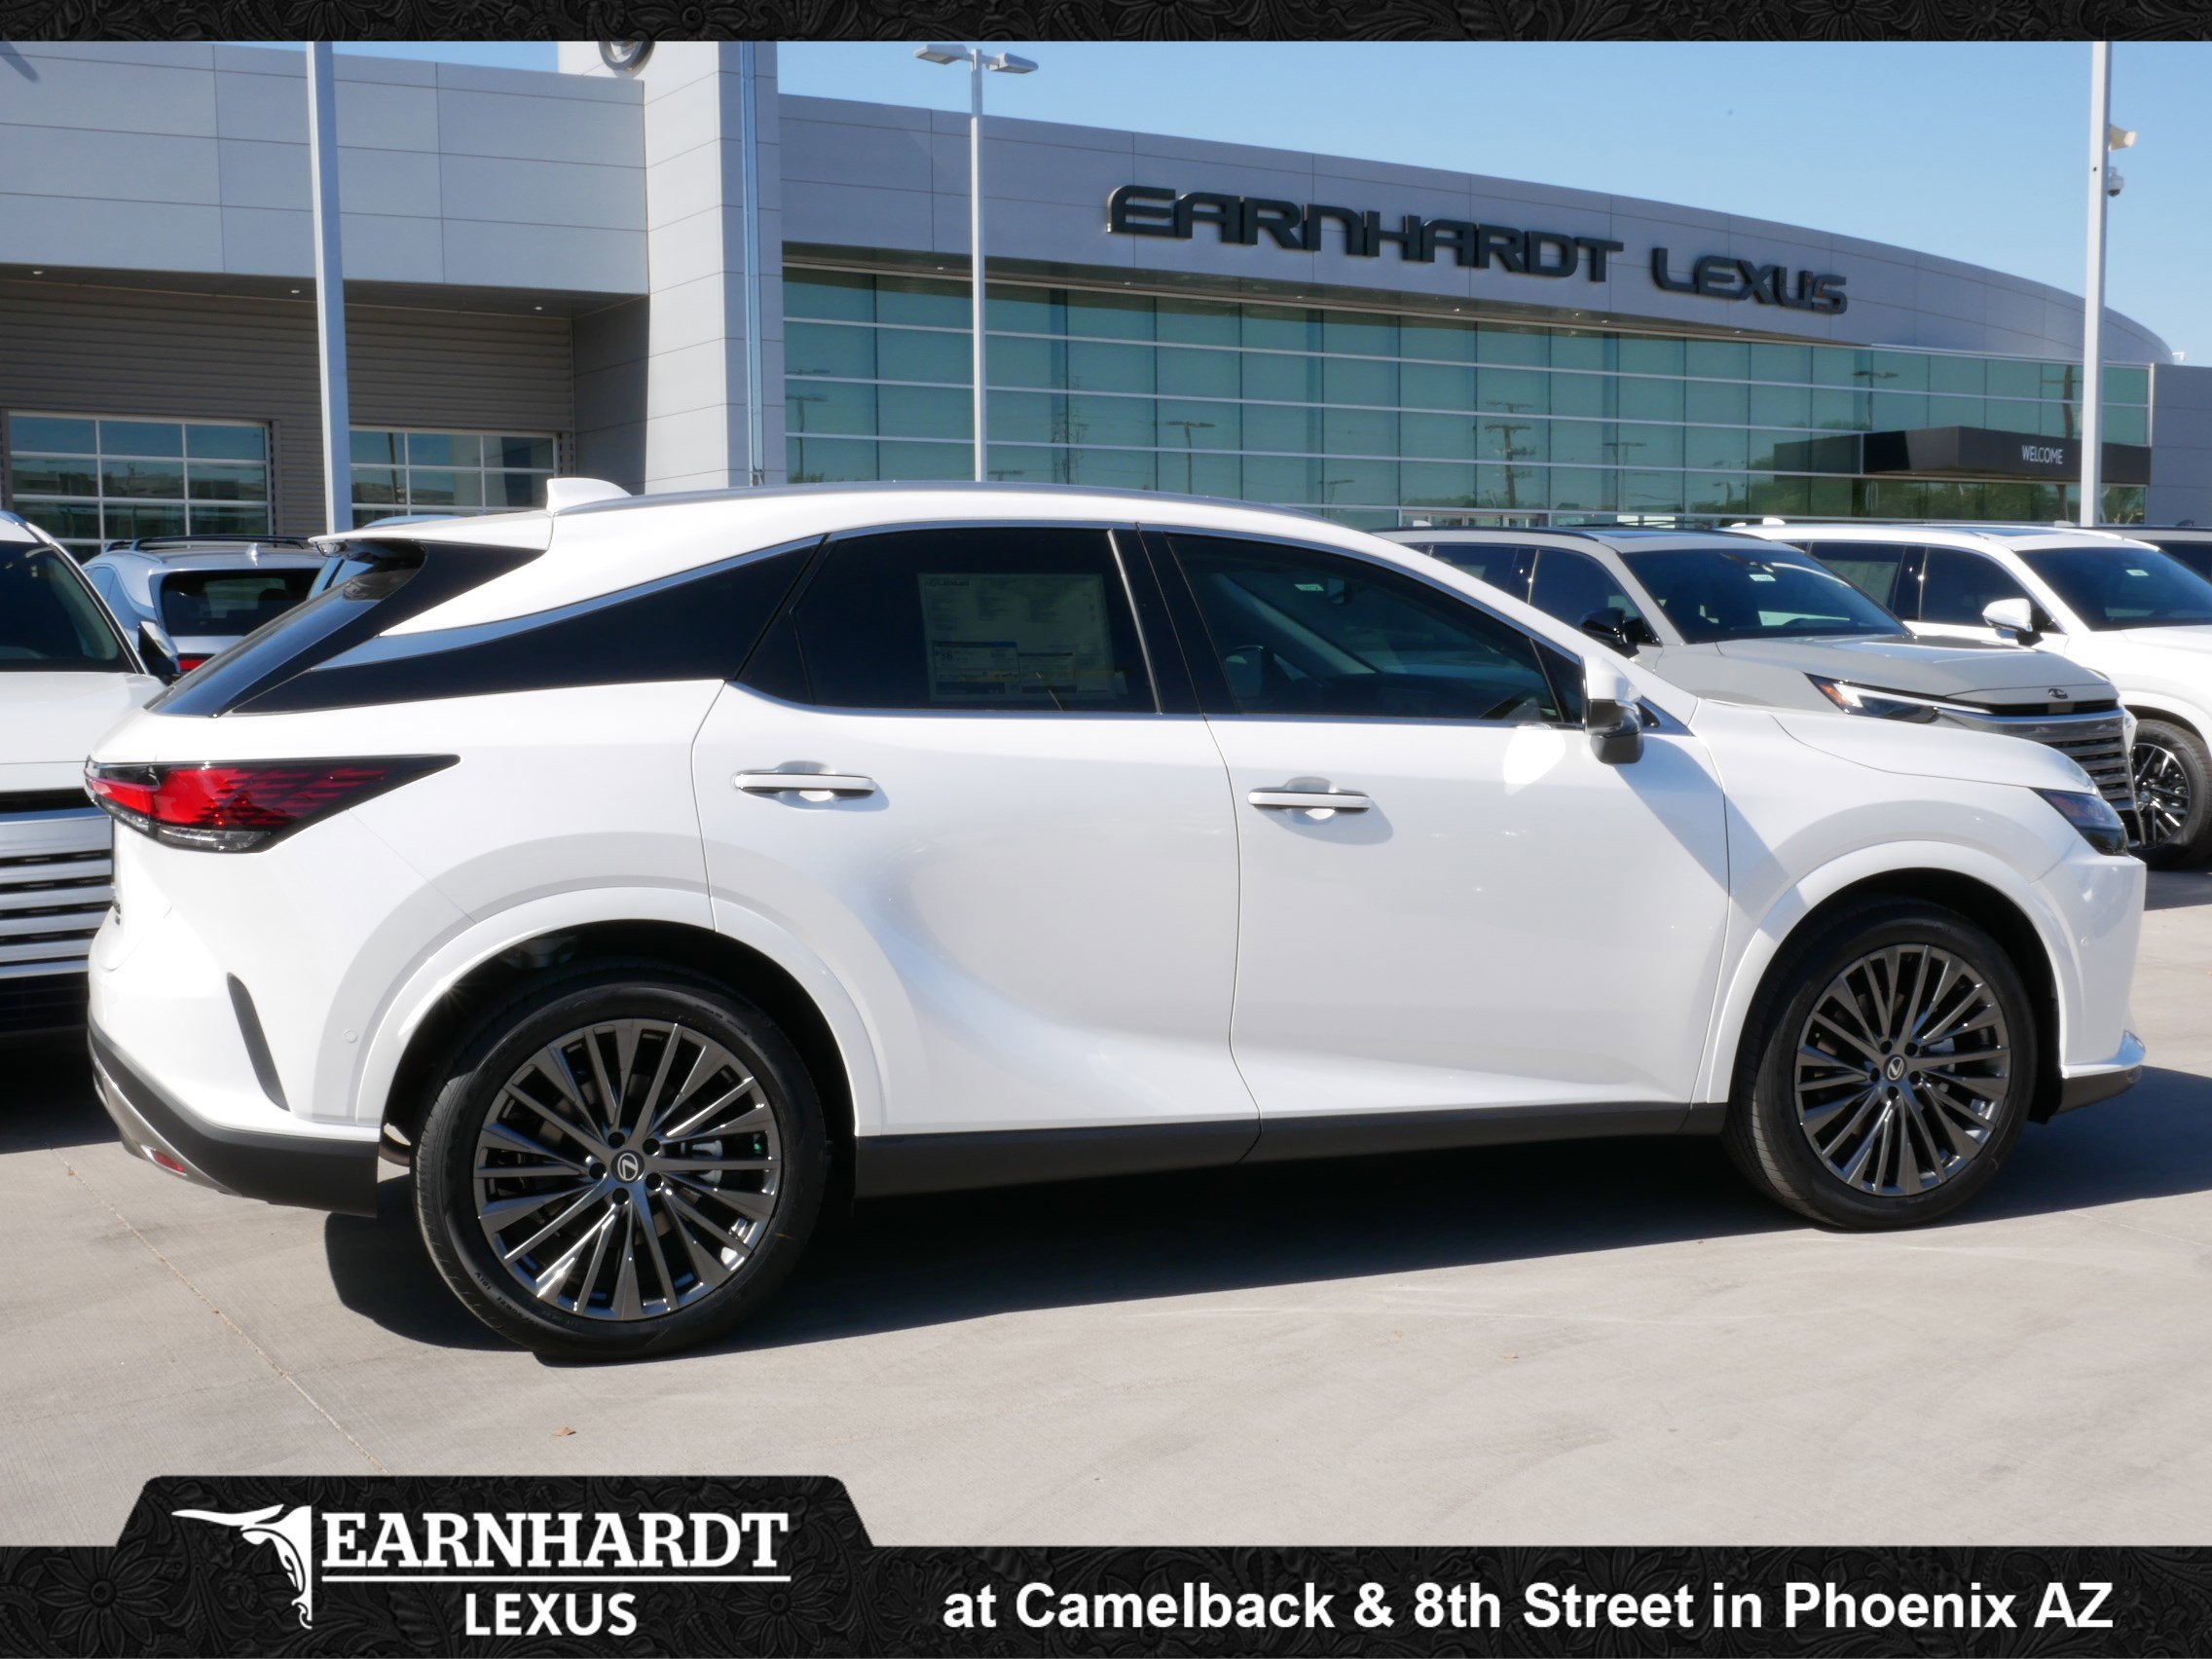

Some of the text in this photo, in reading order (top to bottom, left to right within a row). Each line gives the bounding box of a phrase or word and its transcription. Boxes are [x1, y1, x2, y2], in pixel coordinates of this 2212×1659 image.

[1106, 184, 1848, 315] EARNHARDT LEXUS
[2021, 445, 2064, 464] WELCOME
